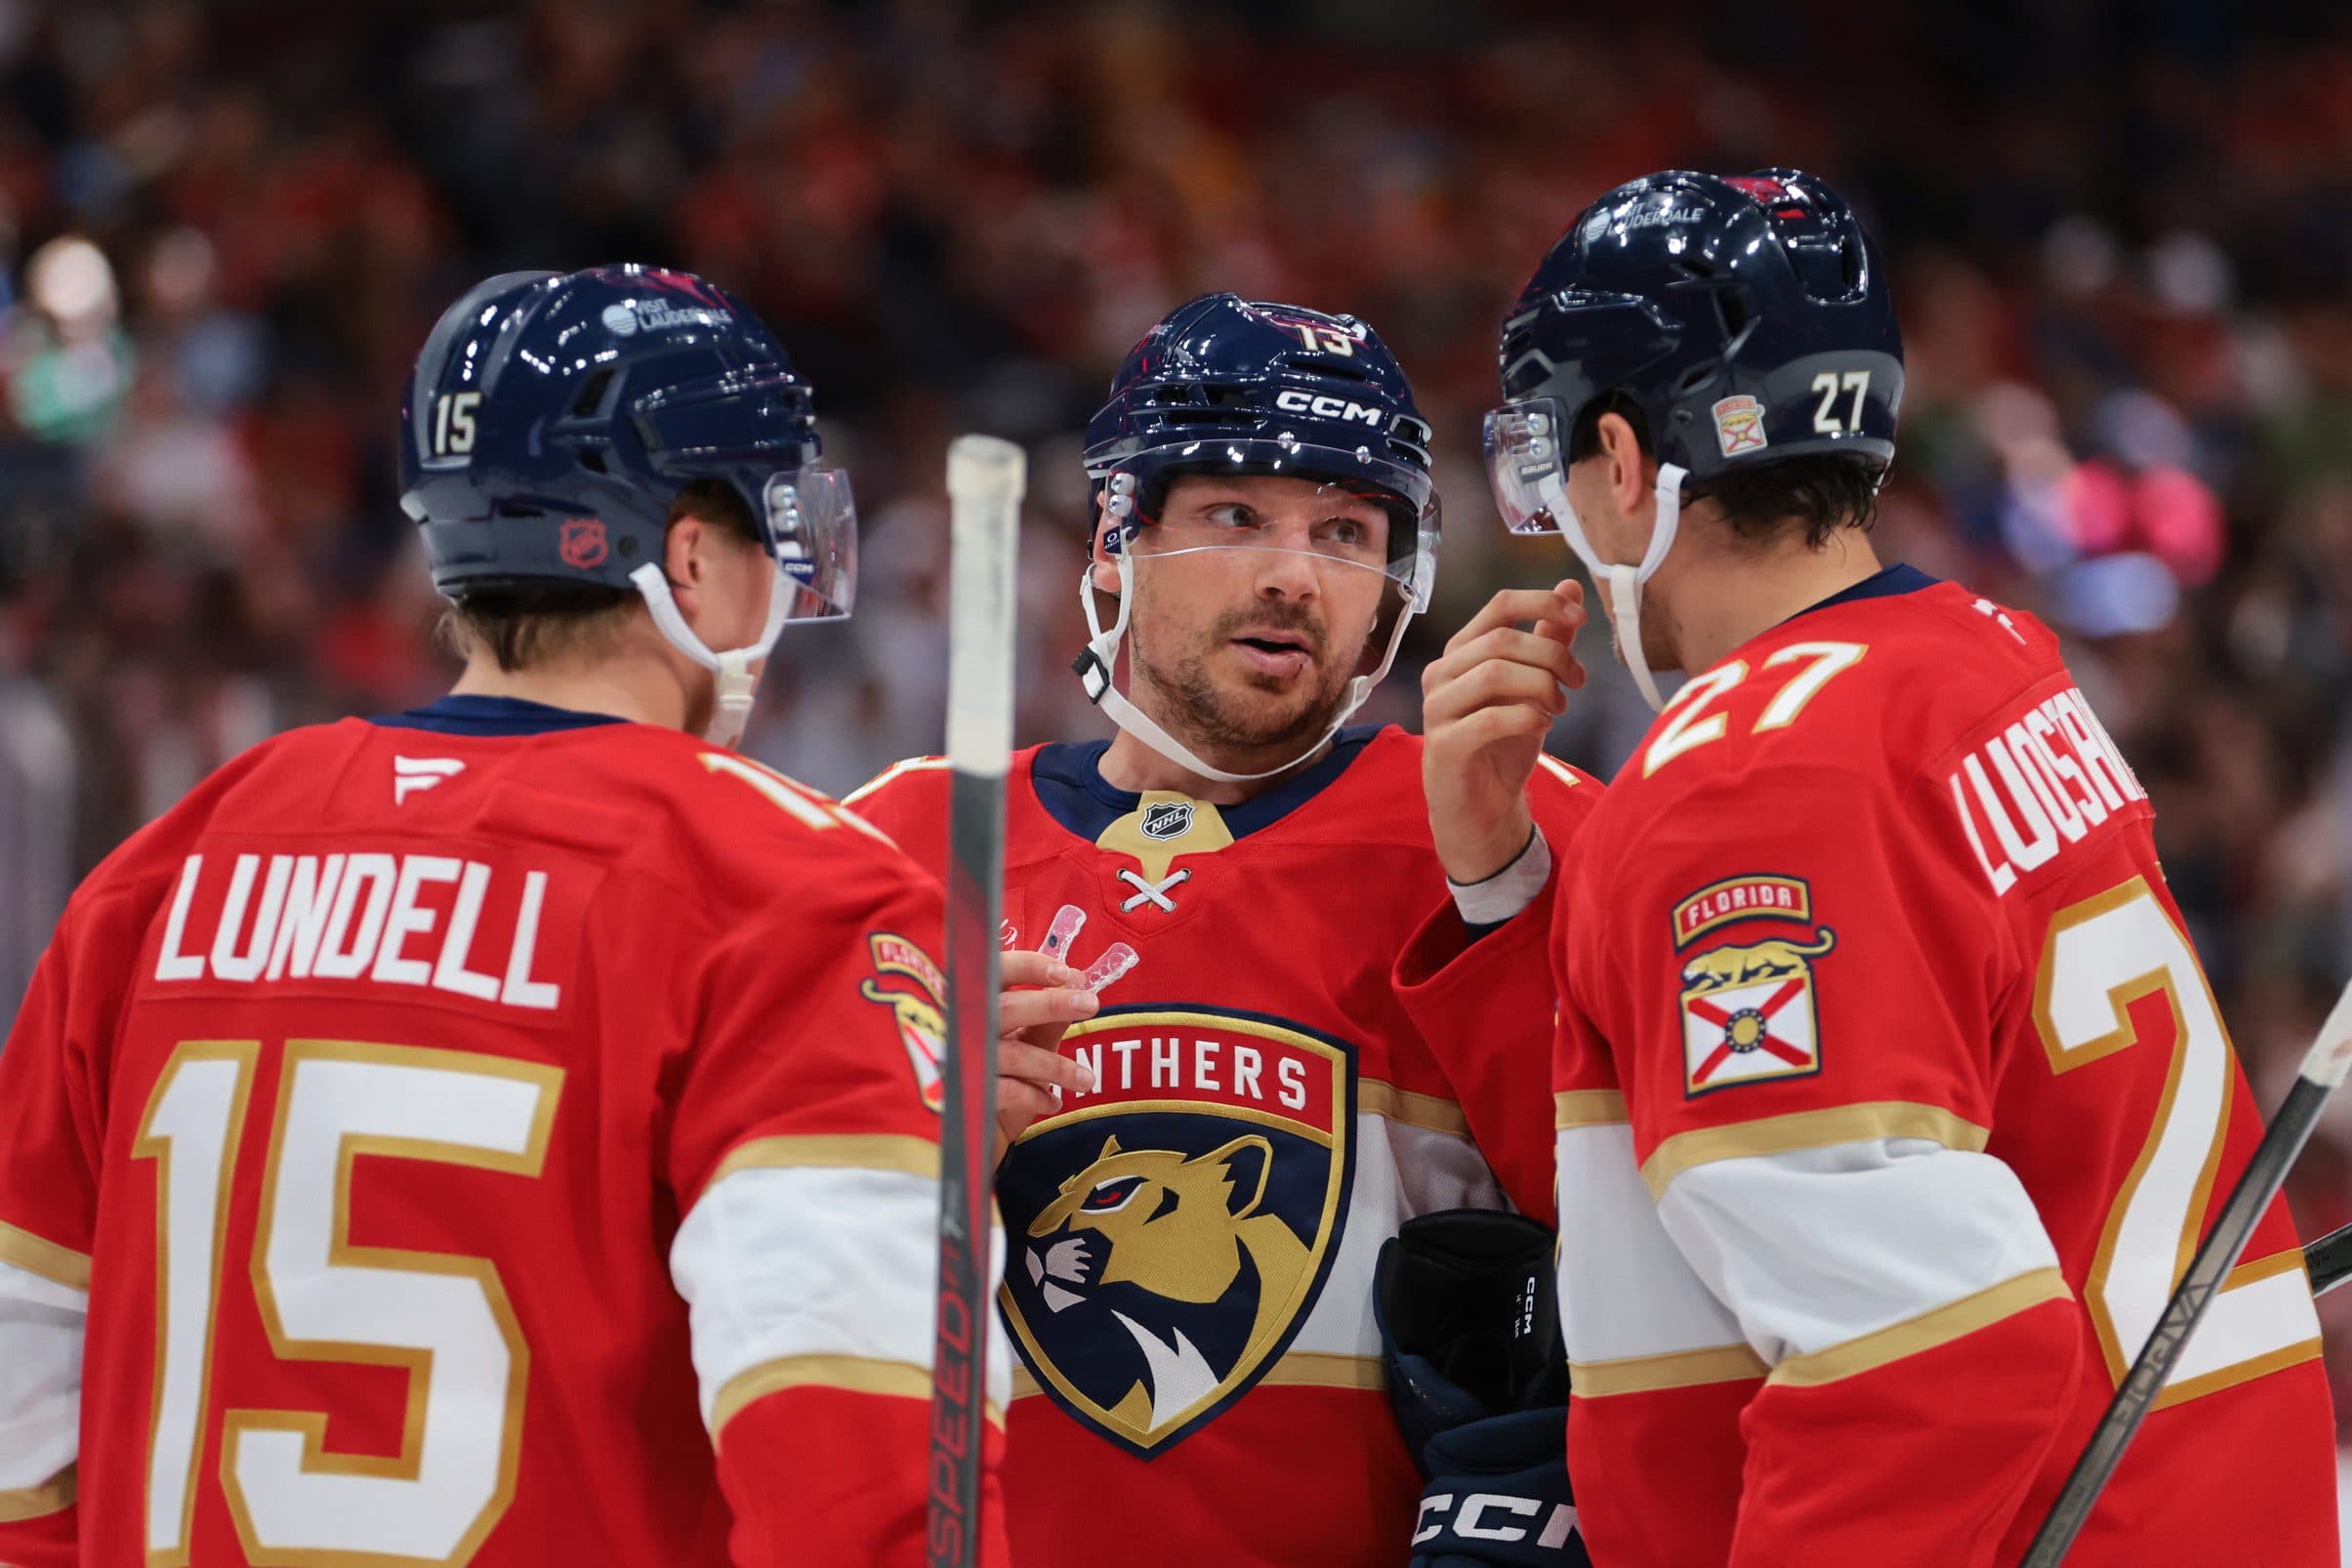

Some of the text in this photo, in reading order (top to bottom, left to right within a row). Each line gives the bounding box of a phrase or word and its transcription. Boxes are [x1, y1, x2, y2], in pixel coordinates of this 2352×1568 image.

[1606, 208, 1704, 235] LUDERDALE
[1296, 324, 1355, 358] 13
[435, 392, 481, 455] 15
[1276, 391, 1382, 426] CCM
[1811, 370, 1872, 433] 27
[1642, 640, 1870, 780] 27
[1152, 811, 1184, 832] NHL
[155, 853, 560, 1009] LUNDELL
[1687, 885, 1793, 928] FLORIDA
[1049, 1037, 1307, 1111] NTHERS
[131, 1038, 566, 1568] 15
[1523, 1276, 1536, 1336] CCM
